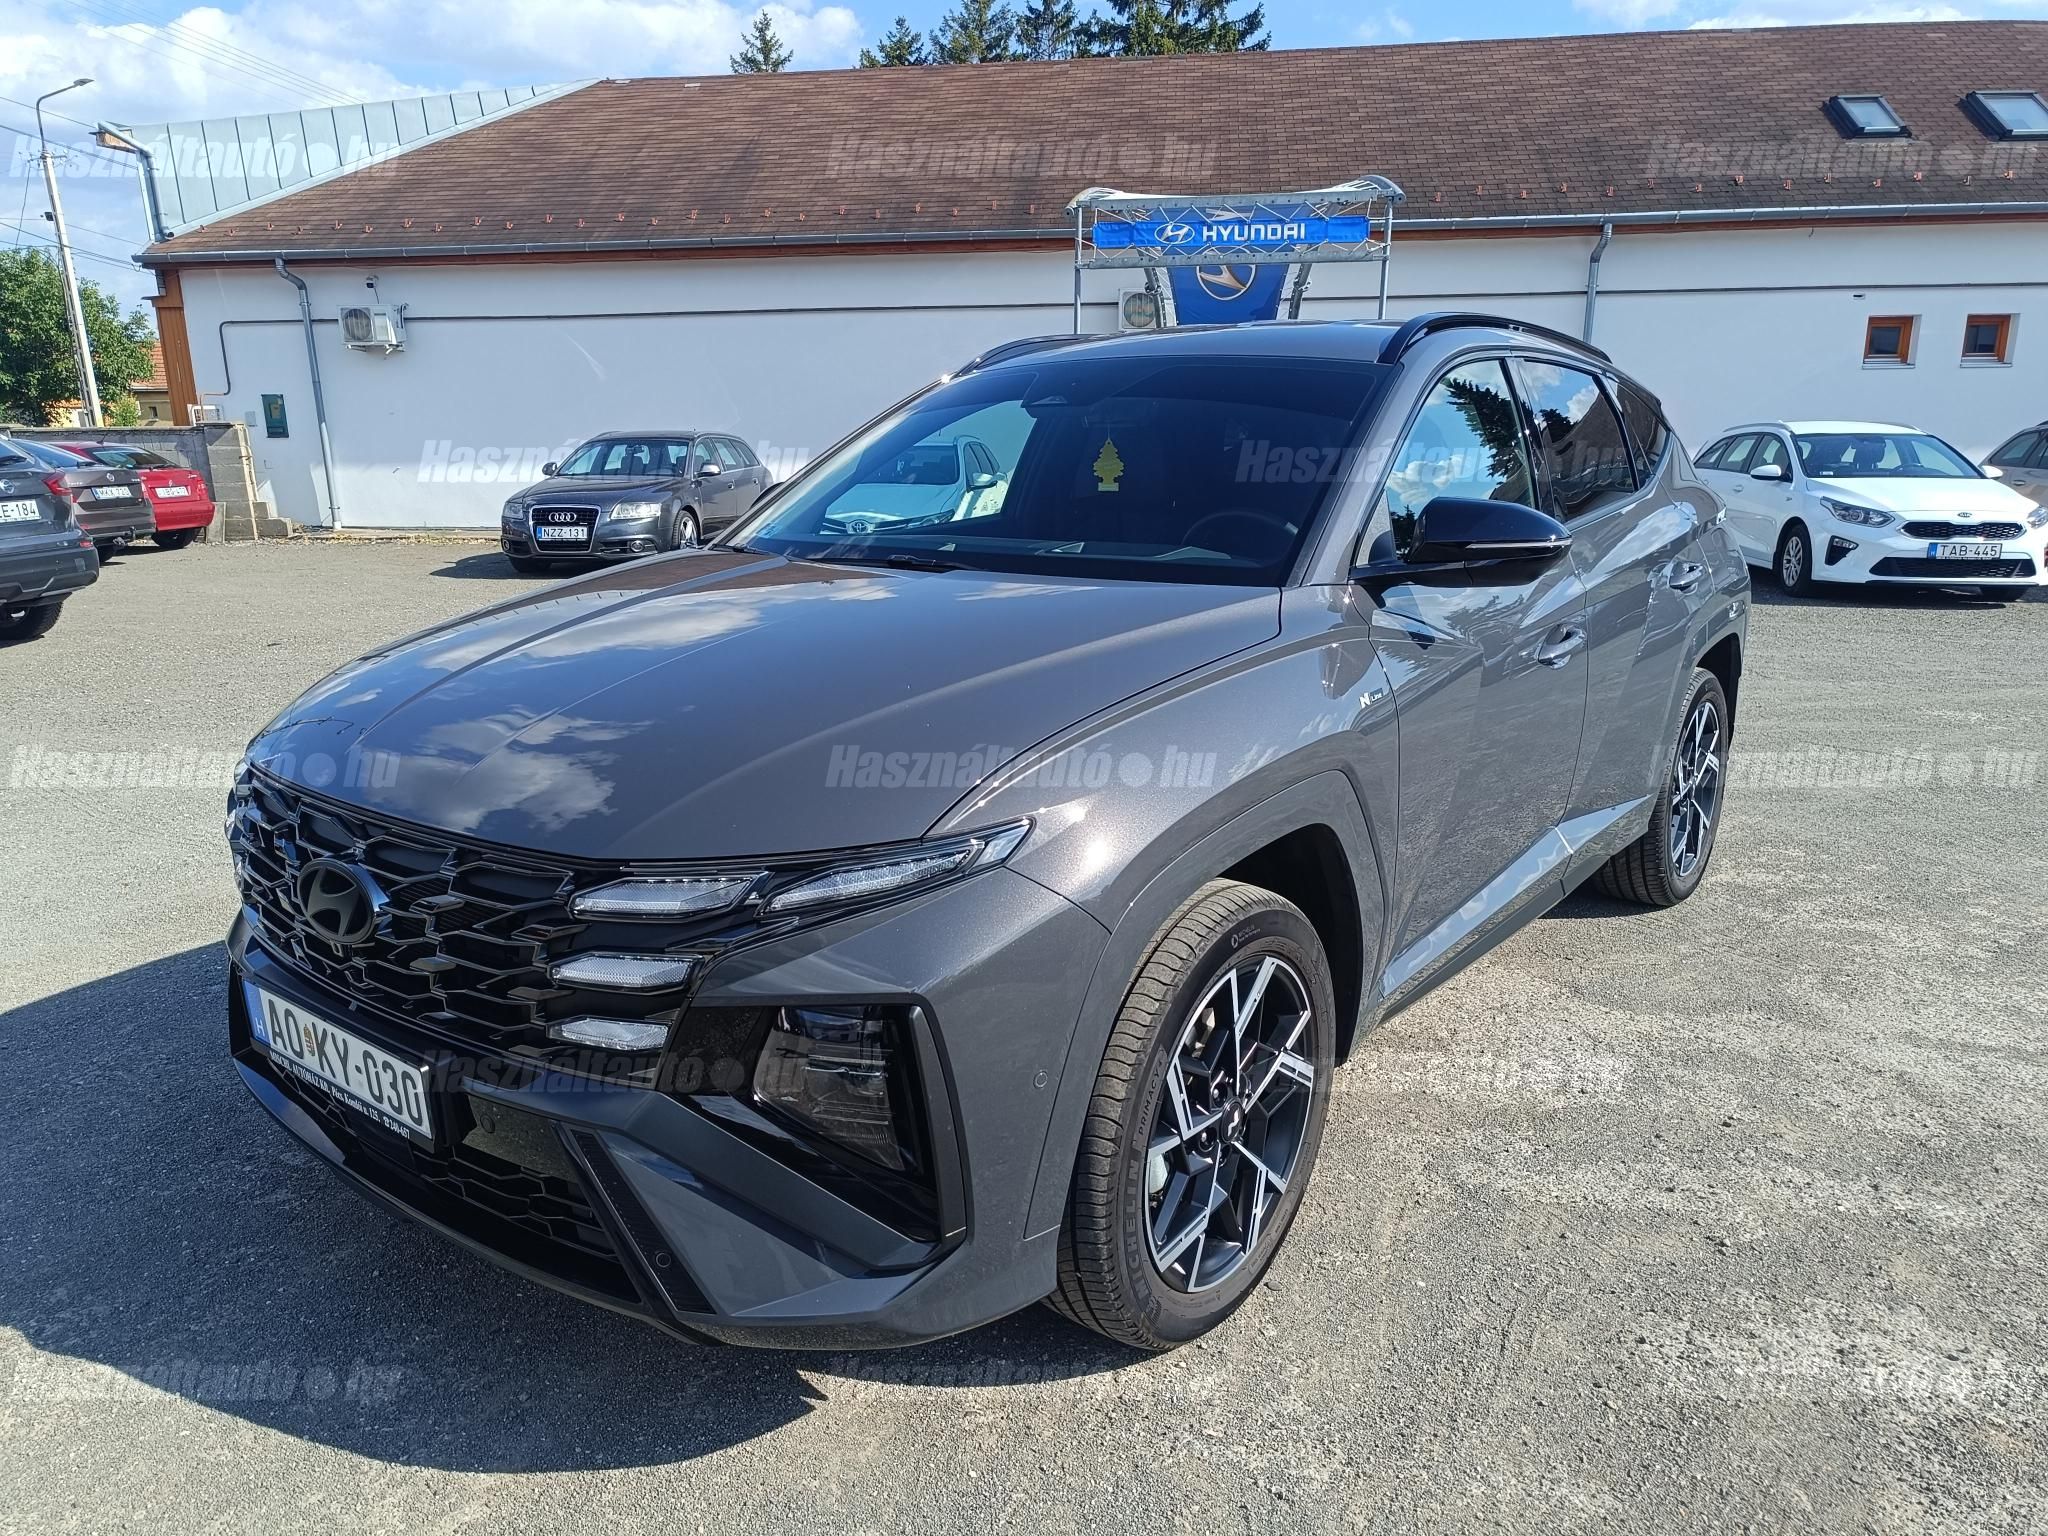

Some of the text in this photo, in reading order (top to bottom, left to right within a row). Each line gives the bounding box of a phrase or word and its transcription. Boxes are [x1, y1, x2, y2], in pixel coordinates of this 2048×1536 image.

[1202, 222, 1306, 242] HYUNDAI
[0, 502, 37, 518] E-184
[543, 528, 586, 538] NZZ-131
[1940, 544, 1998, 557] TAB-445
[1138, 1066, 1160, 1136] PRIMACY
[1124, 1158, 1151, 1305] MICHELIN
